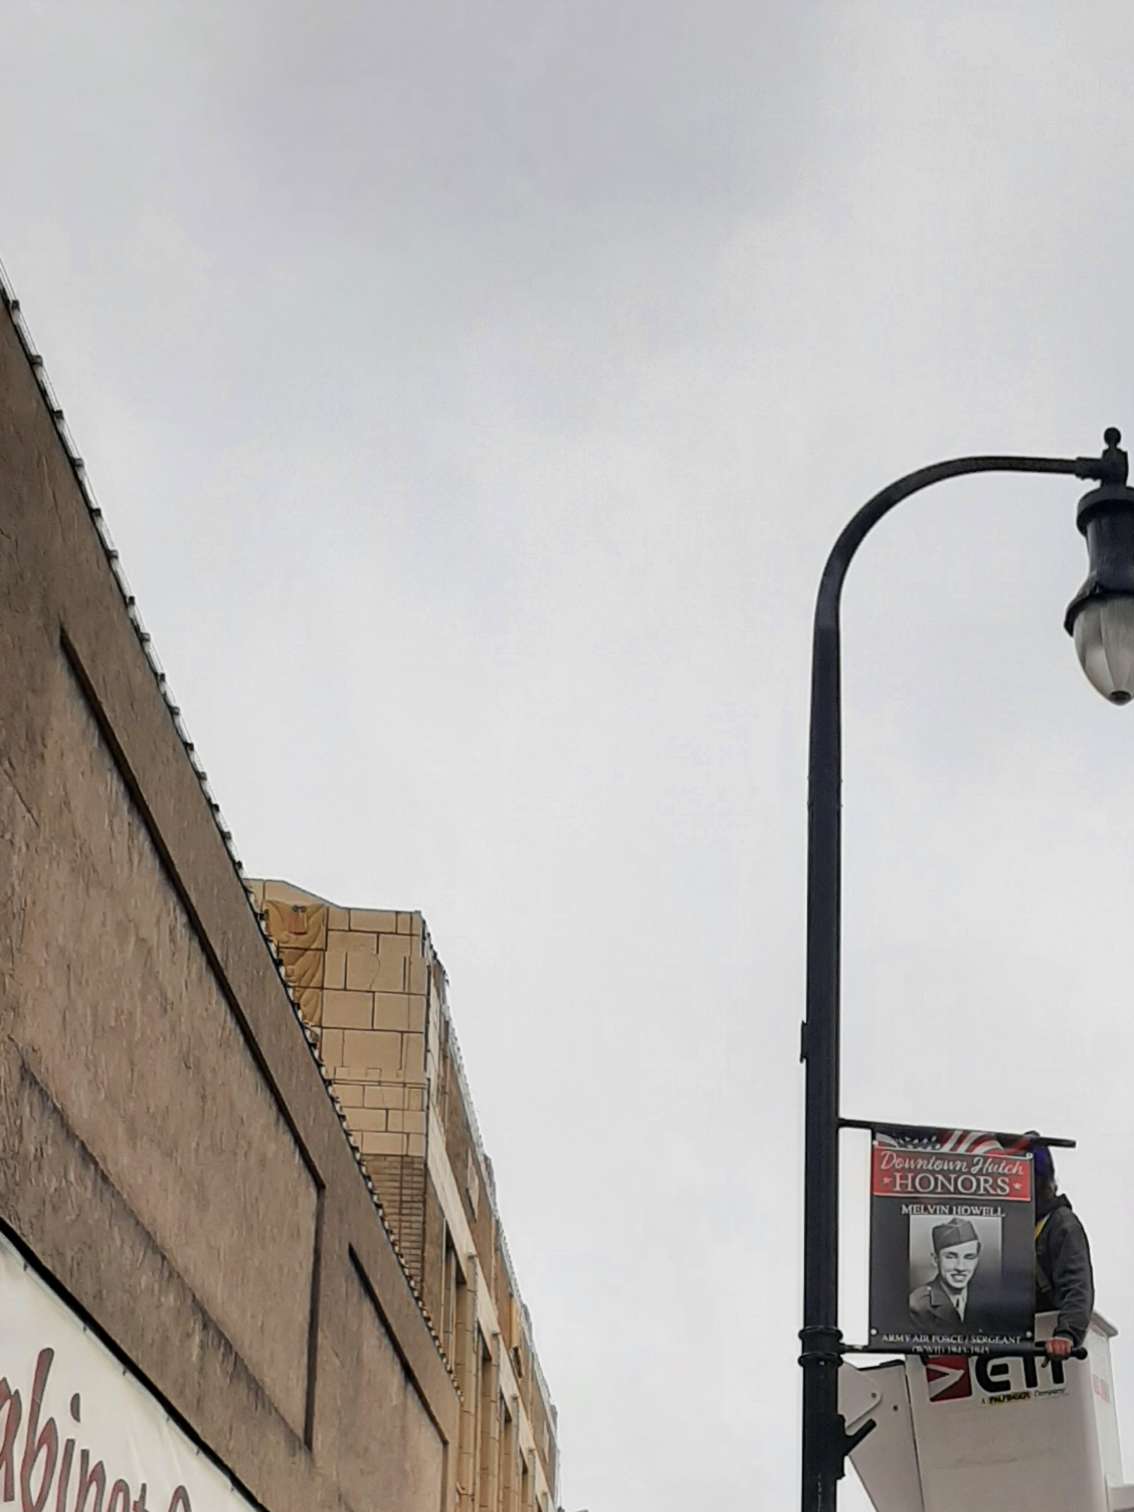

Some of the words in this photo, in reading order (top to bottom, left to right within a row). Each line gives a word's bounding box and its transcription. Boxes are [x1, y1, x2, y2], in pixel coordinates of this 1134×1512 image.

[880, 1151, 968, 1172] Downtown
[970, 1156, 1025, 1176] Hutch
[893, 1172, 1010, 1196] HONORS
[901, 1203, 950, 1217] MELVIN
[953, 1205, 1006, 1217] HOWELL
[881, 1333, 911, 1343] ARMY
[971, 1335, 1021, 1345] SERGEANT
